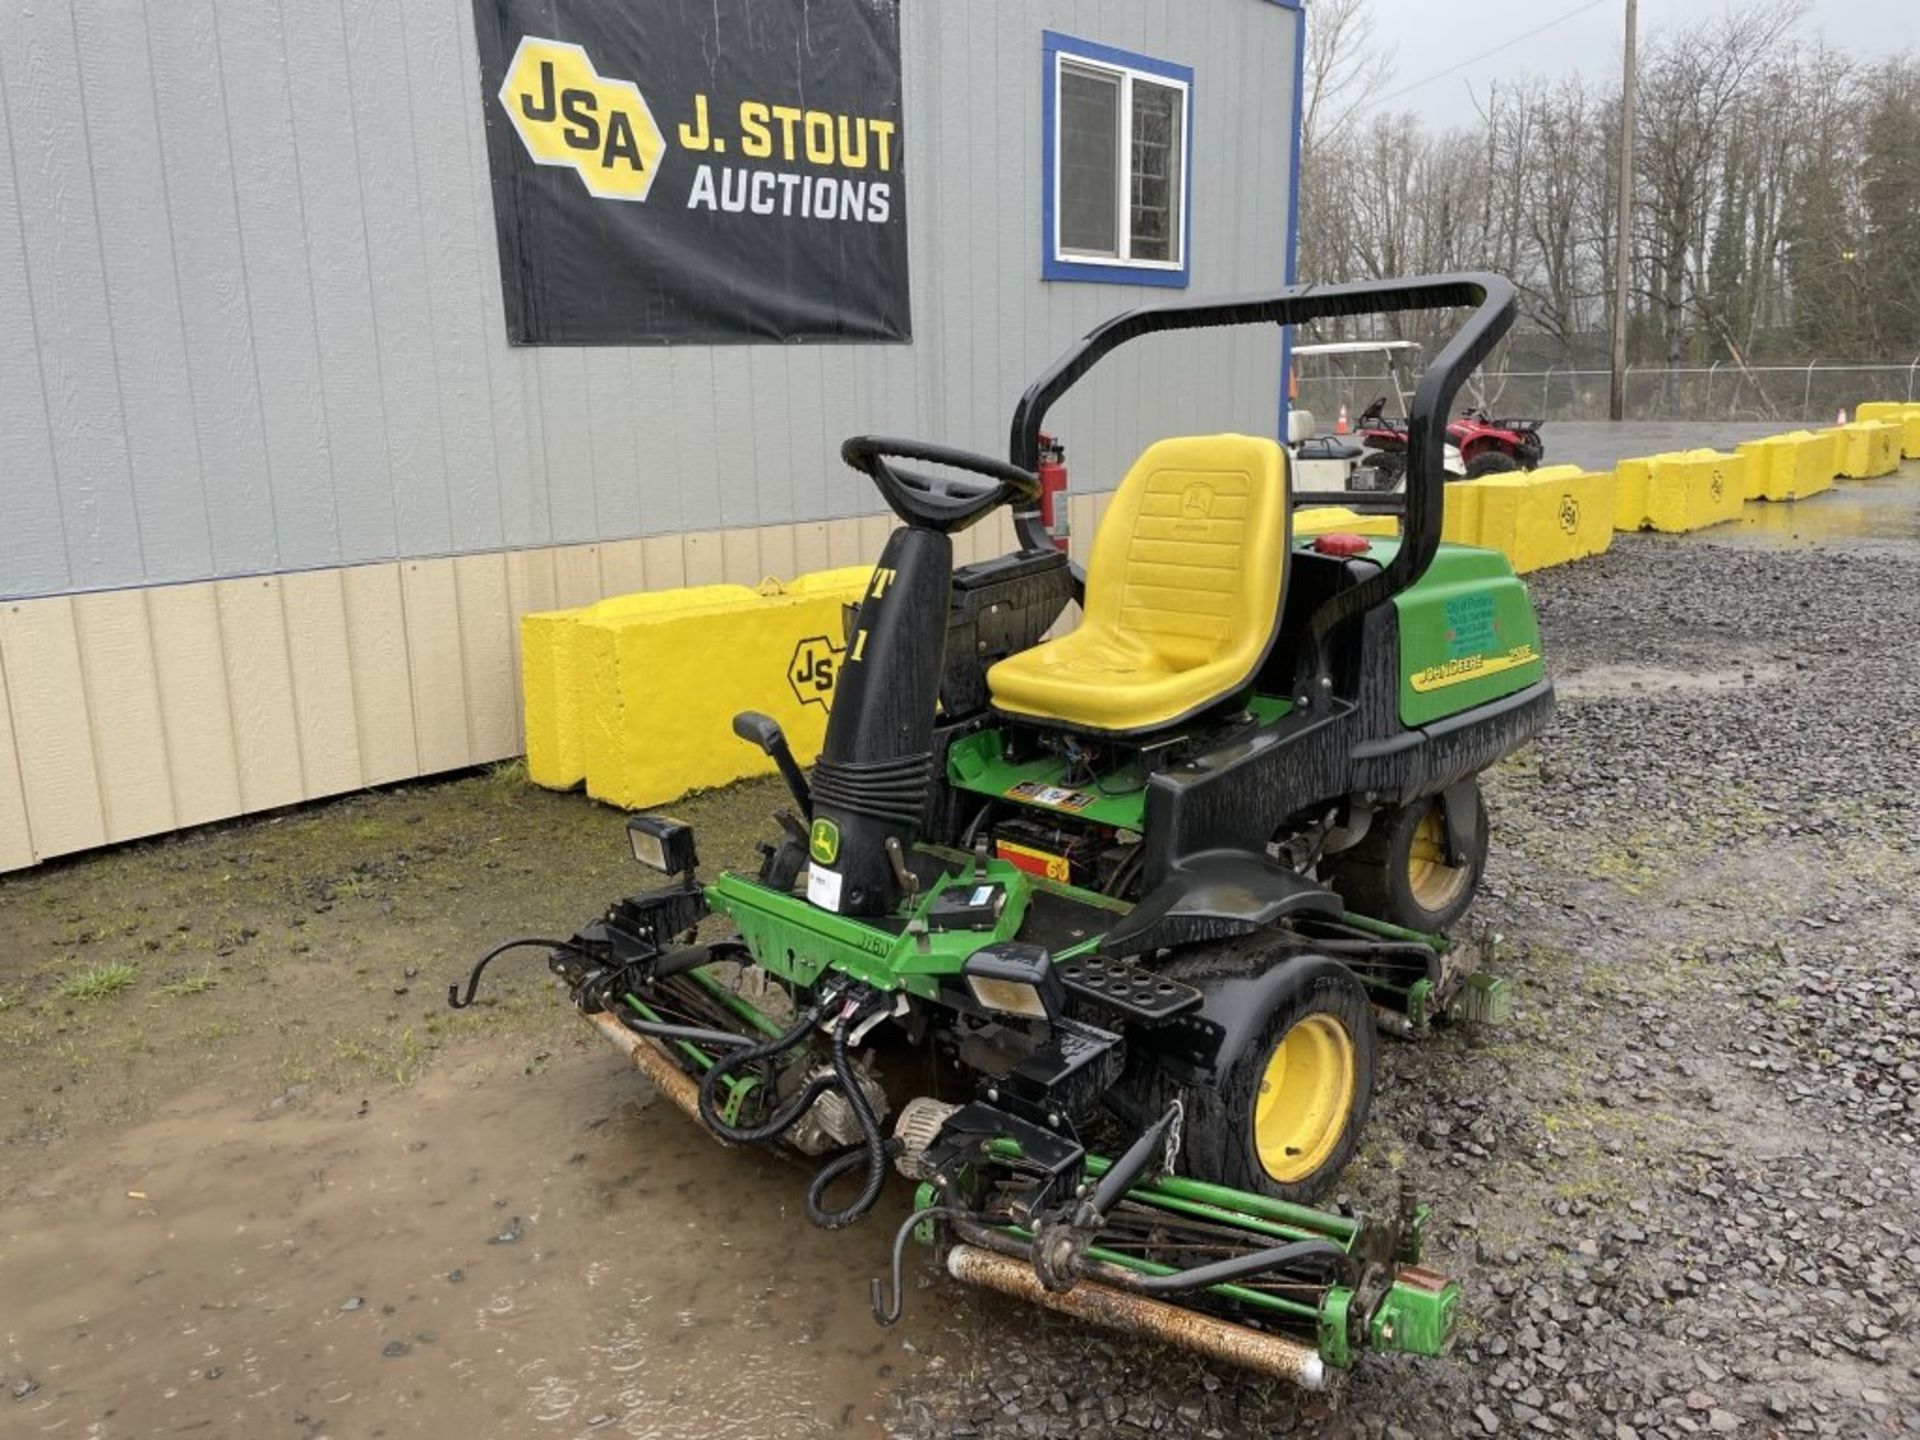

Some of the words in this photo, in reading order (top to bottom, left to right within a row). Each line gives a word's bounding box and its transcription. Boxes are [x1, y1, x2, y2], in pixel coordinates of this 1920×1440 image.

[521, 61, 644, 172] JSA
[678, 94, 725, 153] J.
[740, 102, 895, 171] STOUT
[688, 164, 891, 223] AUCTIONS
[797, 650, 842, 691] JS
